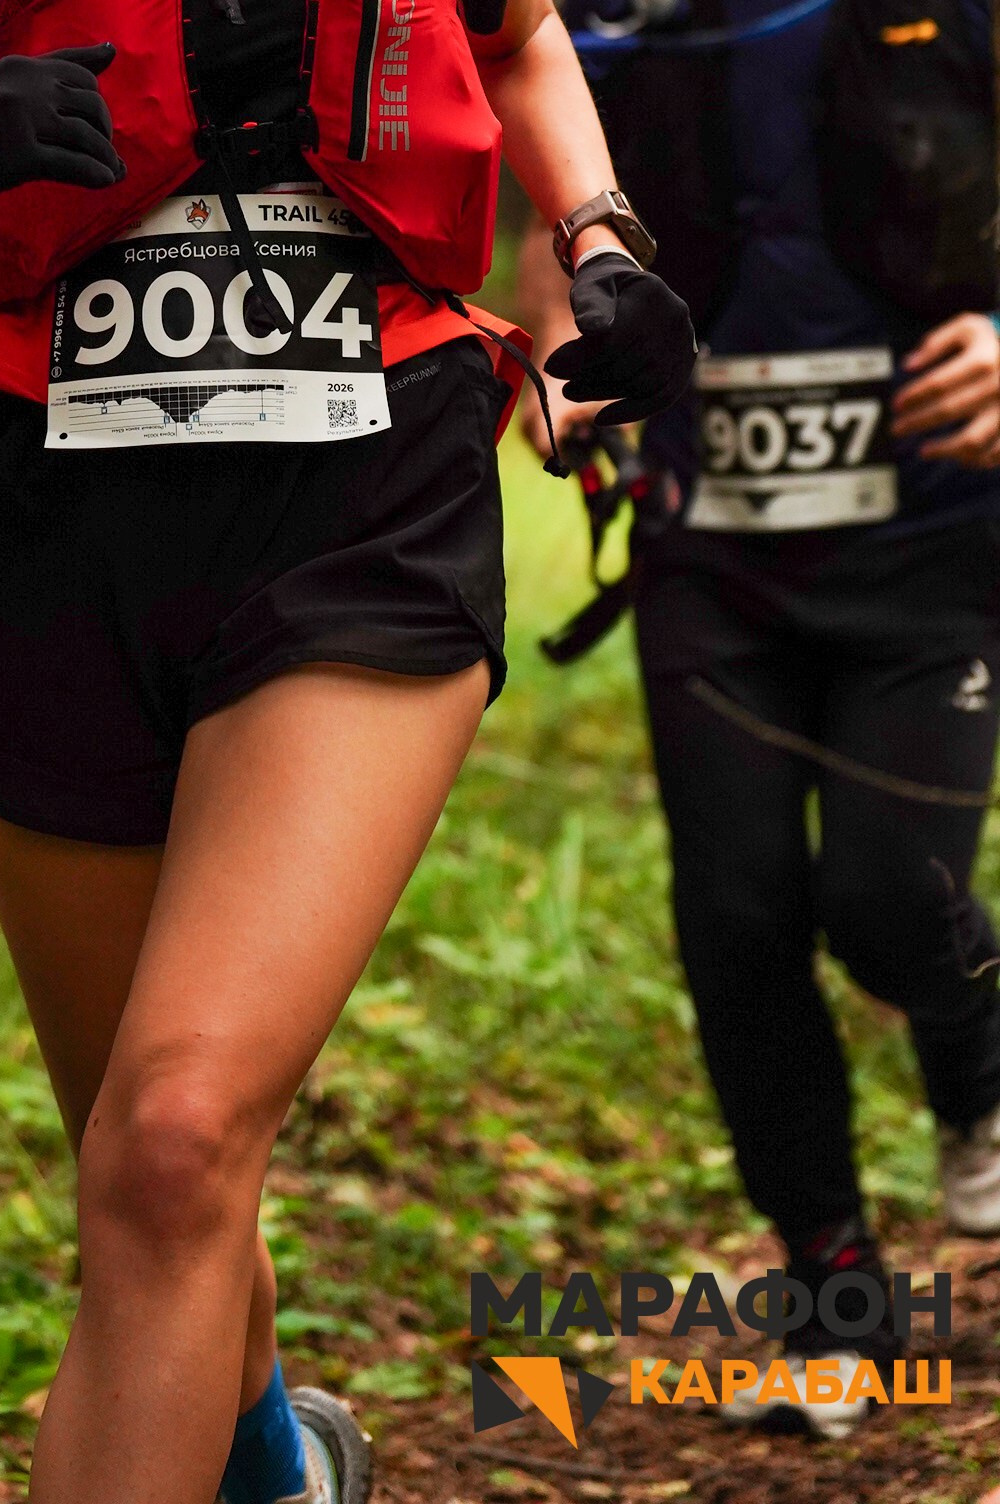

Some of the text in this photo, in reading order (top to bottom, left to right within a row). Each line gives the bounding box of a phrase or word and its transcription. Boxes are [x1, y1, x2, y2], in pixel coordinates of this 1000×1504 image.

[258, 204, 323, 223] TRAIL
[124, 241, 241, 264] Ястребцова
[57, 295, 66, 308] 54
[55, 310, 64, 327] 691
[73, 268, 374, 365] 9004
[53, 328, 63, 349] 996
[53, 350, 62, 363] +7
[327, 383, 354, 393] 2026
[703, 398, 881, 473] 9037
